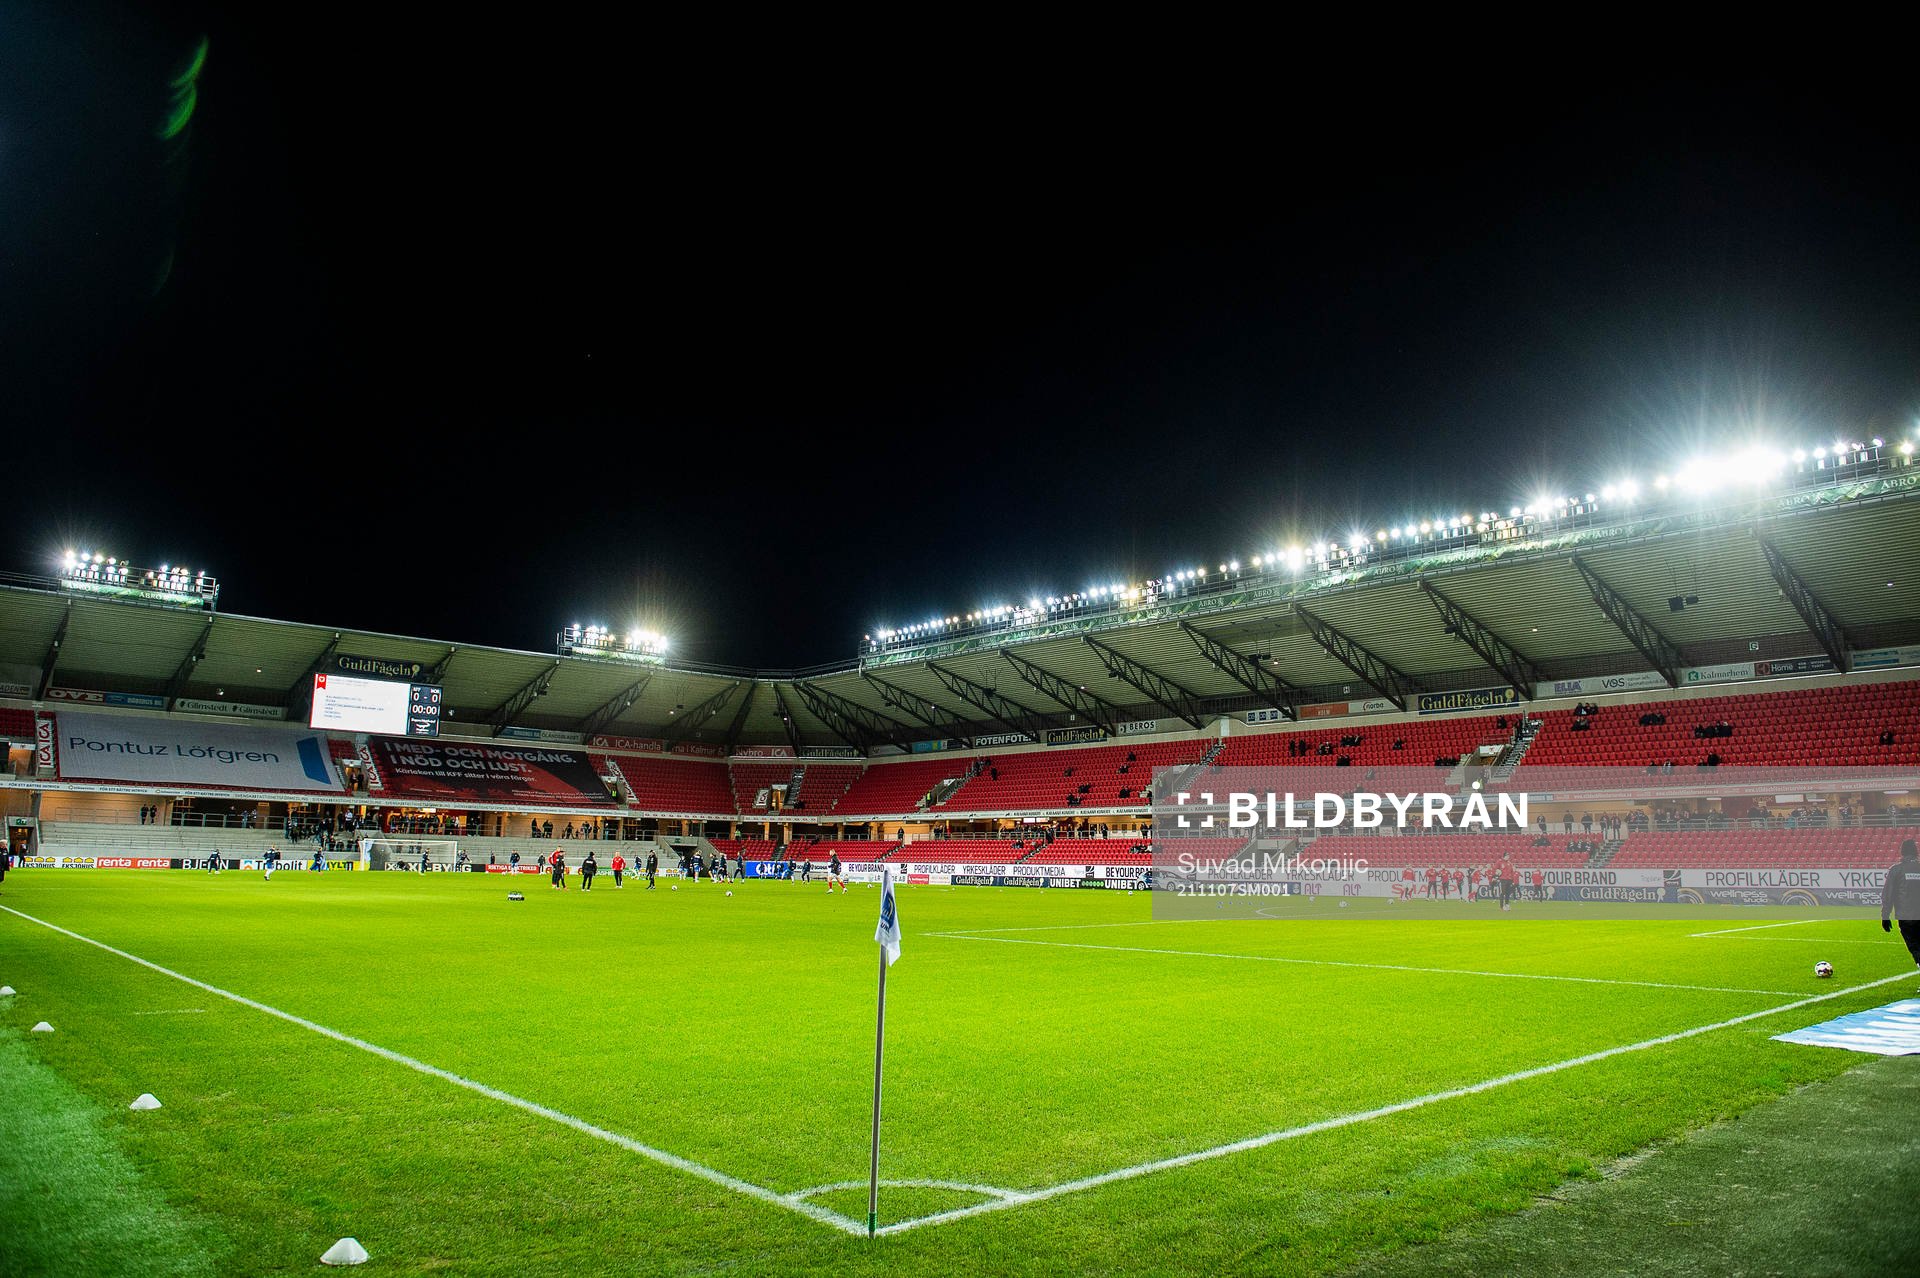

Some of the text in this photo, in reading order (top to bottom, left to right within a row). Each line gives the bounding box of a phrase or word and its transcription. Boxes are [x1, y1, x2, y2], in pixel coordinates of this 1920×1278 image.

[338, 657, 411, 676] GuldFågeln
[1771, 663, 1793, 672] Home
[1700, 669, 1748, 680] Kalmarhem
[49, 689, 104, 702] OVE
[413, 692, 419, 701] 0
[431, 694, 438, 702] 0
[1421, 692, 1503, 710] GuldFågeln
[187, 701, 278, 716] Glimstedt Glimstedt
[412, 704, 437, 715] 00:00
[1129, 721, 1154, 731] BEROS
[592, 736, 609, 747] ICA
[975, 734, 1031, 746] FOTEN FOTE
[1048, 730, 1098, 744] GuldFågeln
[70, 737, 279, 764] Pontuz Löfgren
[394, 743, 441, 755] MED-
[444, 746, 484, 758] OCH
[487, 750, 577, 763] MOTGÅNG.
[771, 748, 787, 757] ICA
[400, 754, 443, 767] NÖD
[446, 758, 486, 770] OCH
[488, 761, 532, 773] LUST.
[98, 858, 170, 868] renta renta
[848, 864, 884, 872] BE YOUR BRAND
[914, 864, 1065, 876] PROFILKLÄDER YRKESKLÄDER PRODUKTMEDIA
[1106, 867, 1116, 878] BE
[1116, 867, 1134, 878] YOUR
[955, 877, 990, 887] GuldFågeln
[1003, 878, 1039, 888] GuldFågeln
[1049, 878, 1138, 889] UNIBET UNIBET
[1543, 871, 1572, 885] YOUR
[1575, 871, 1617, 885] BRAND
[1706, 869, 1820, 887] PROFILKLÄDER
[1580, 887, 1655, 903] GuldFågeln
[1710, 889, 1883, 899] wellness wellnes
